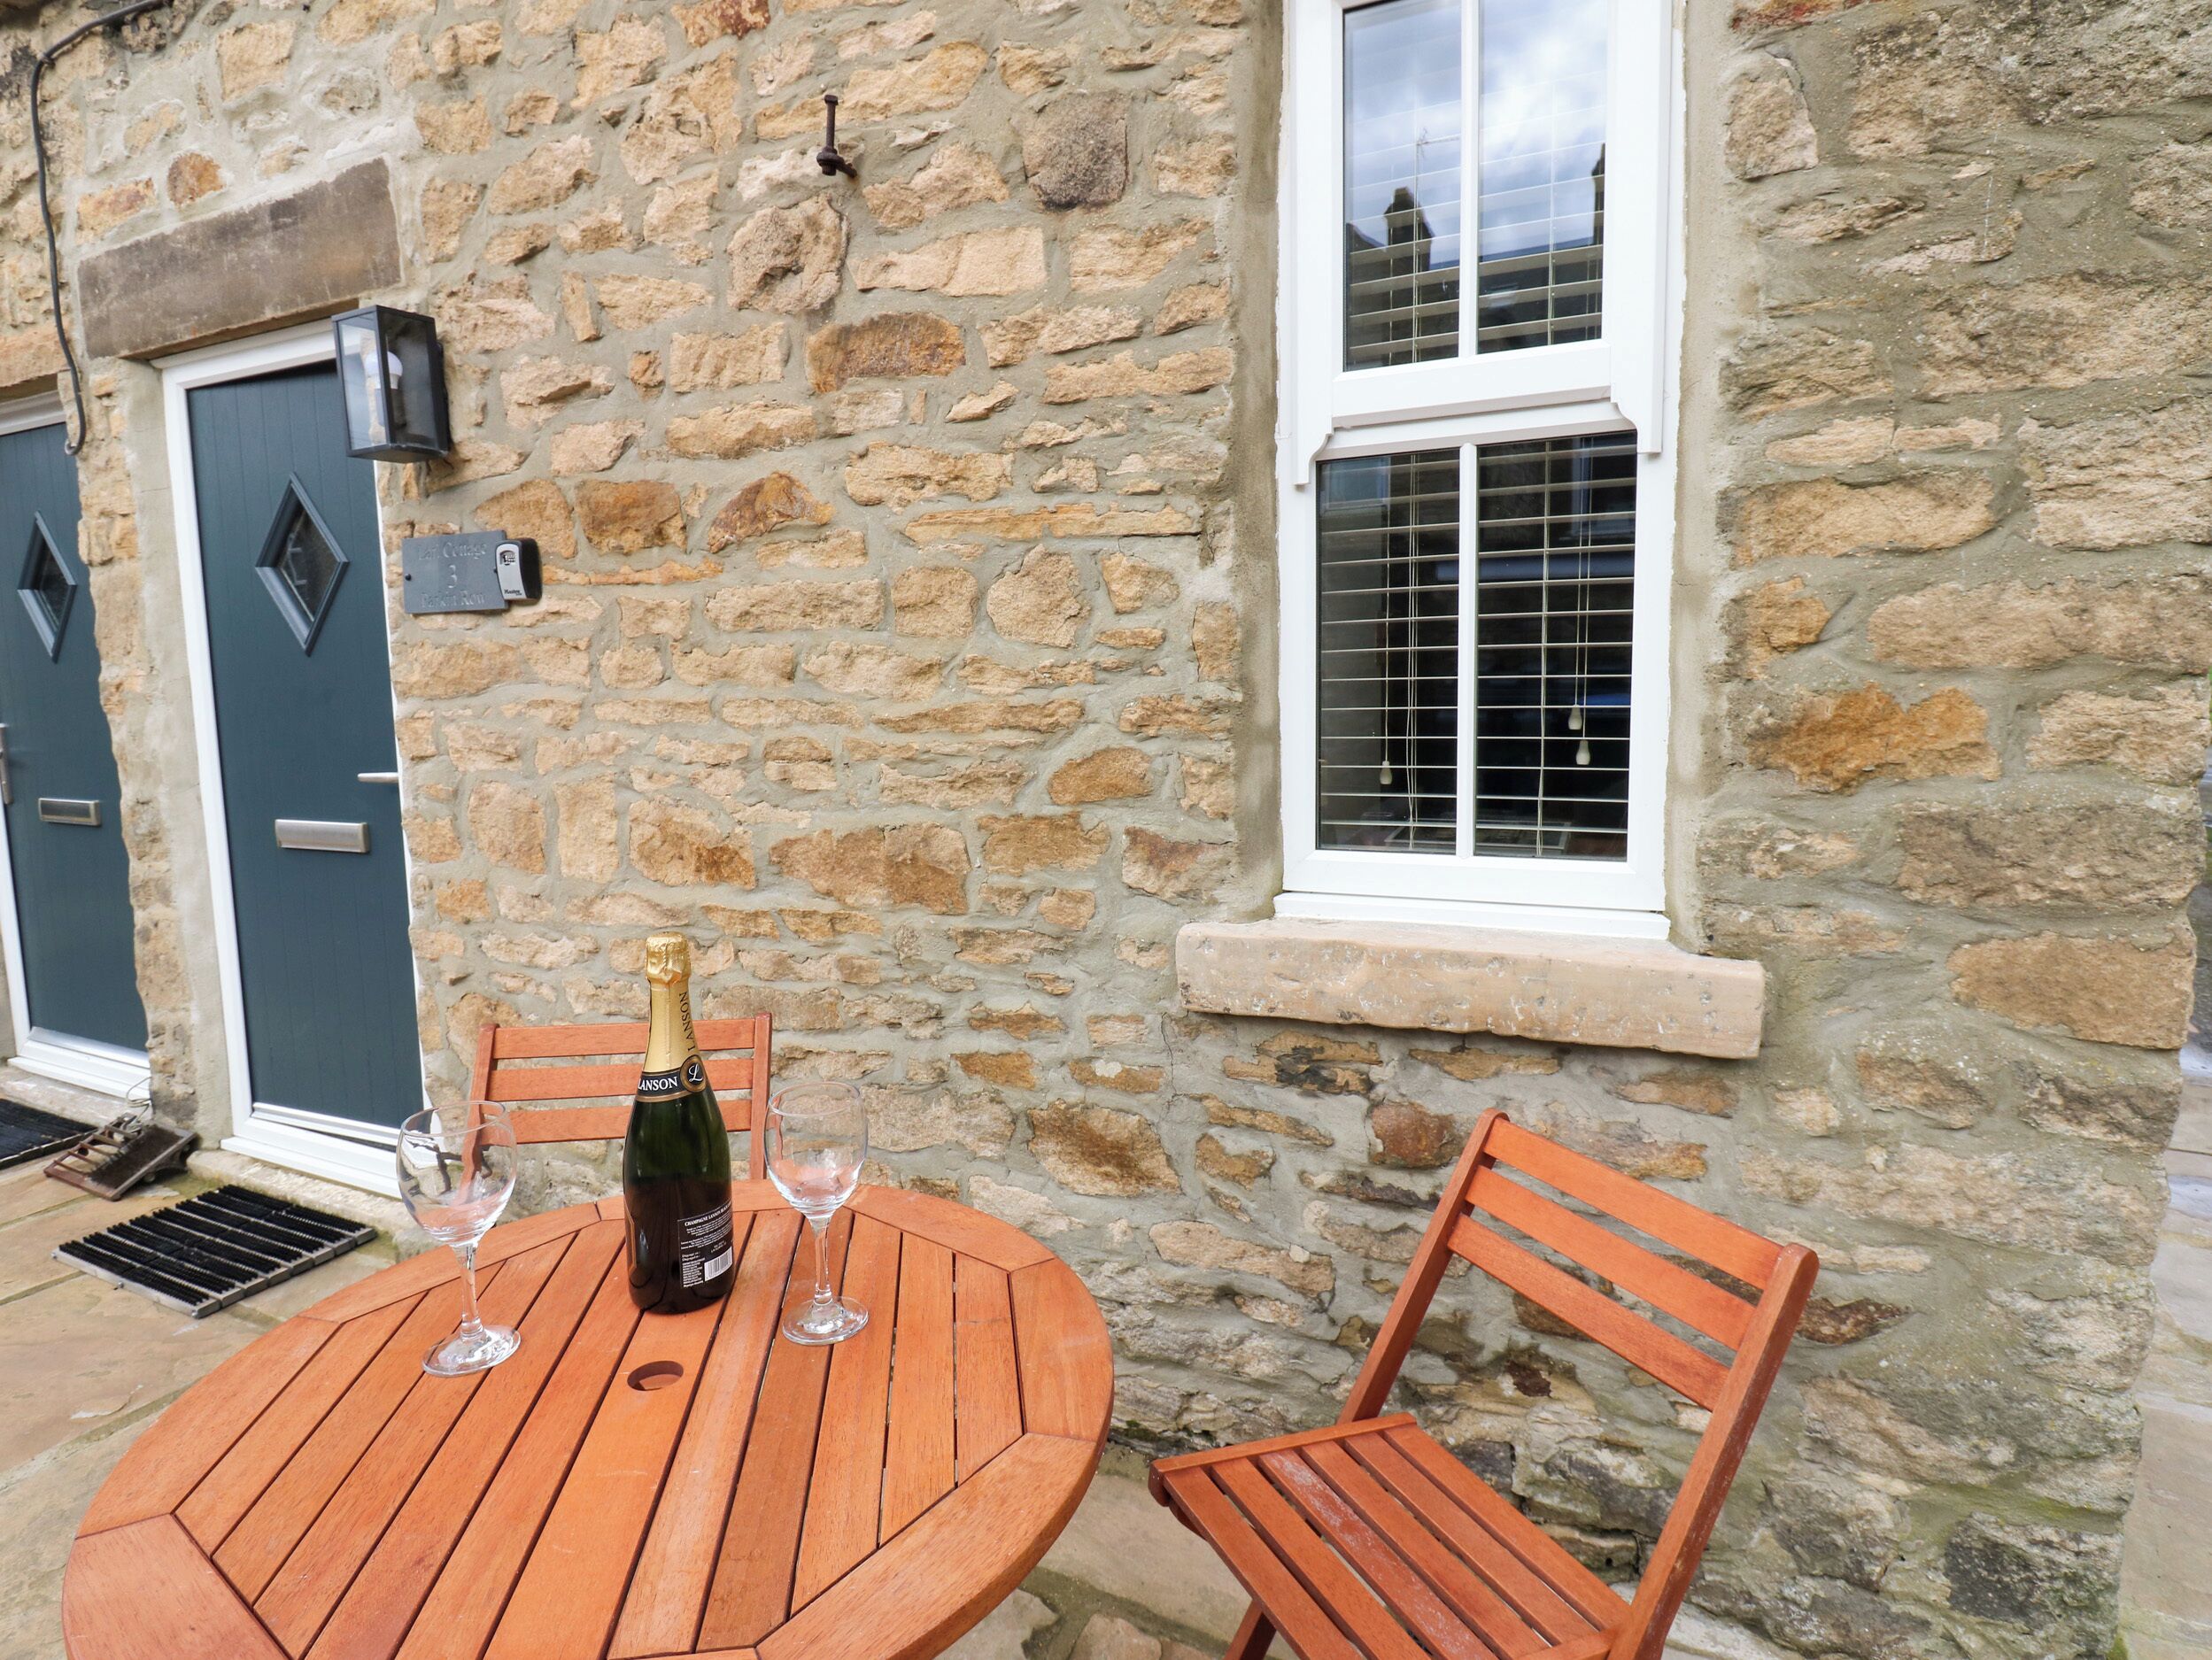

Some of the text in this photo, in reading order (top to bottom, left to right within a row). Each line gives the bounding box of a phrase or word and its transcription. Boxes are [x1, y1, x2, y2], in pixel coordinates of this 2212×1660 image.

[443, 542, 487, 560] Cottage
[448, 564, 457, 588] 3
[679, 992, 696, 1052] LANSON
[638, 1076, 678, 1091] LANSON
